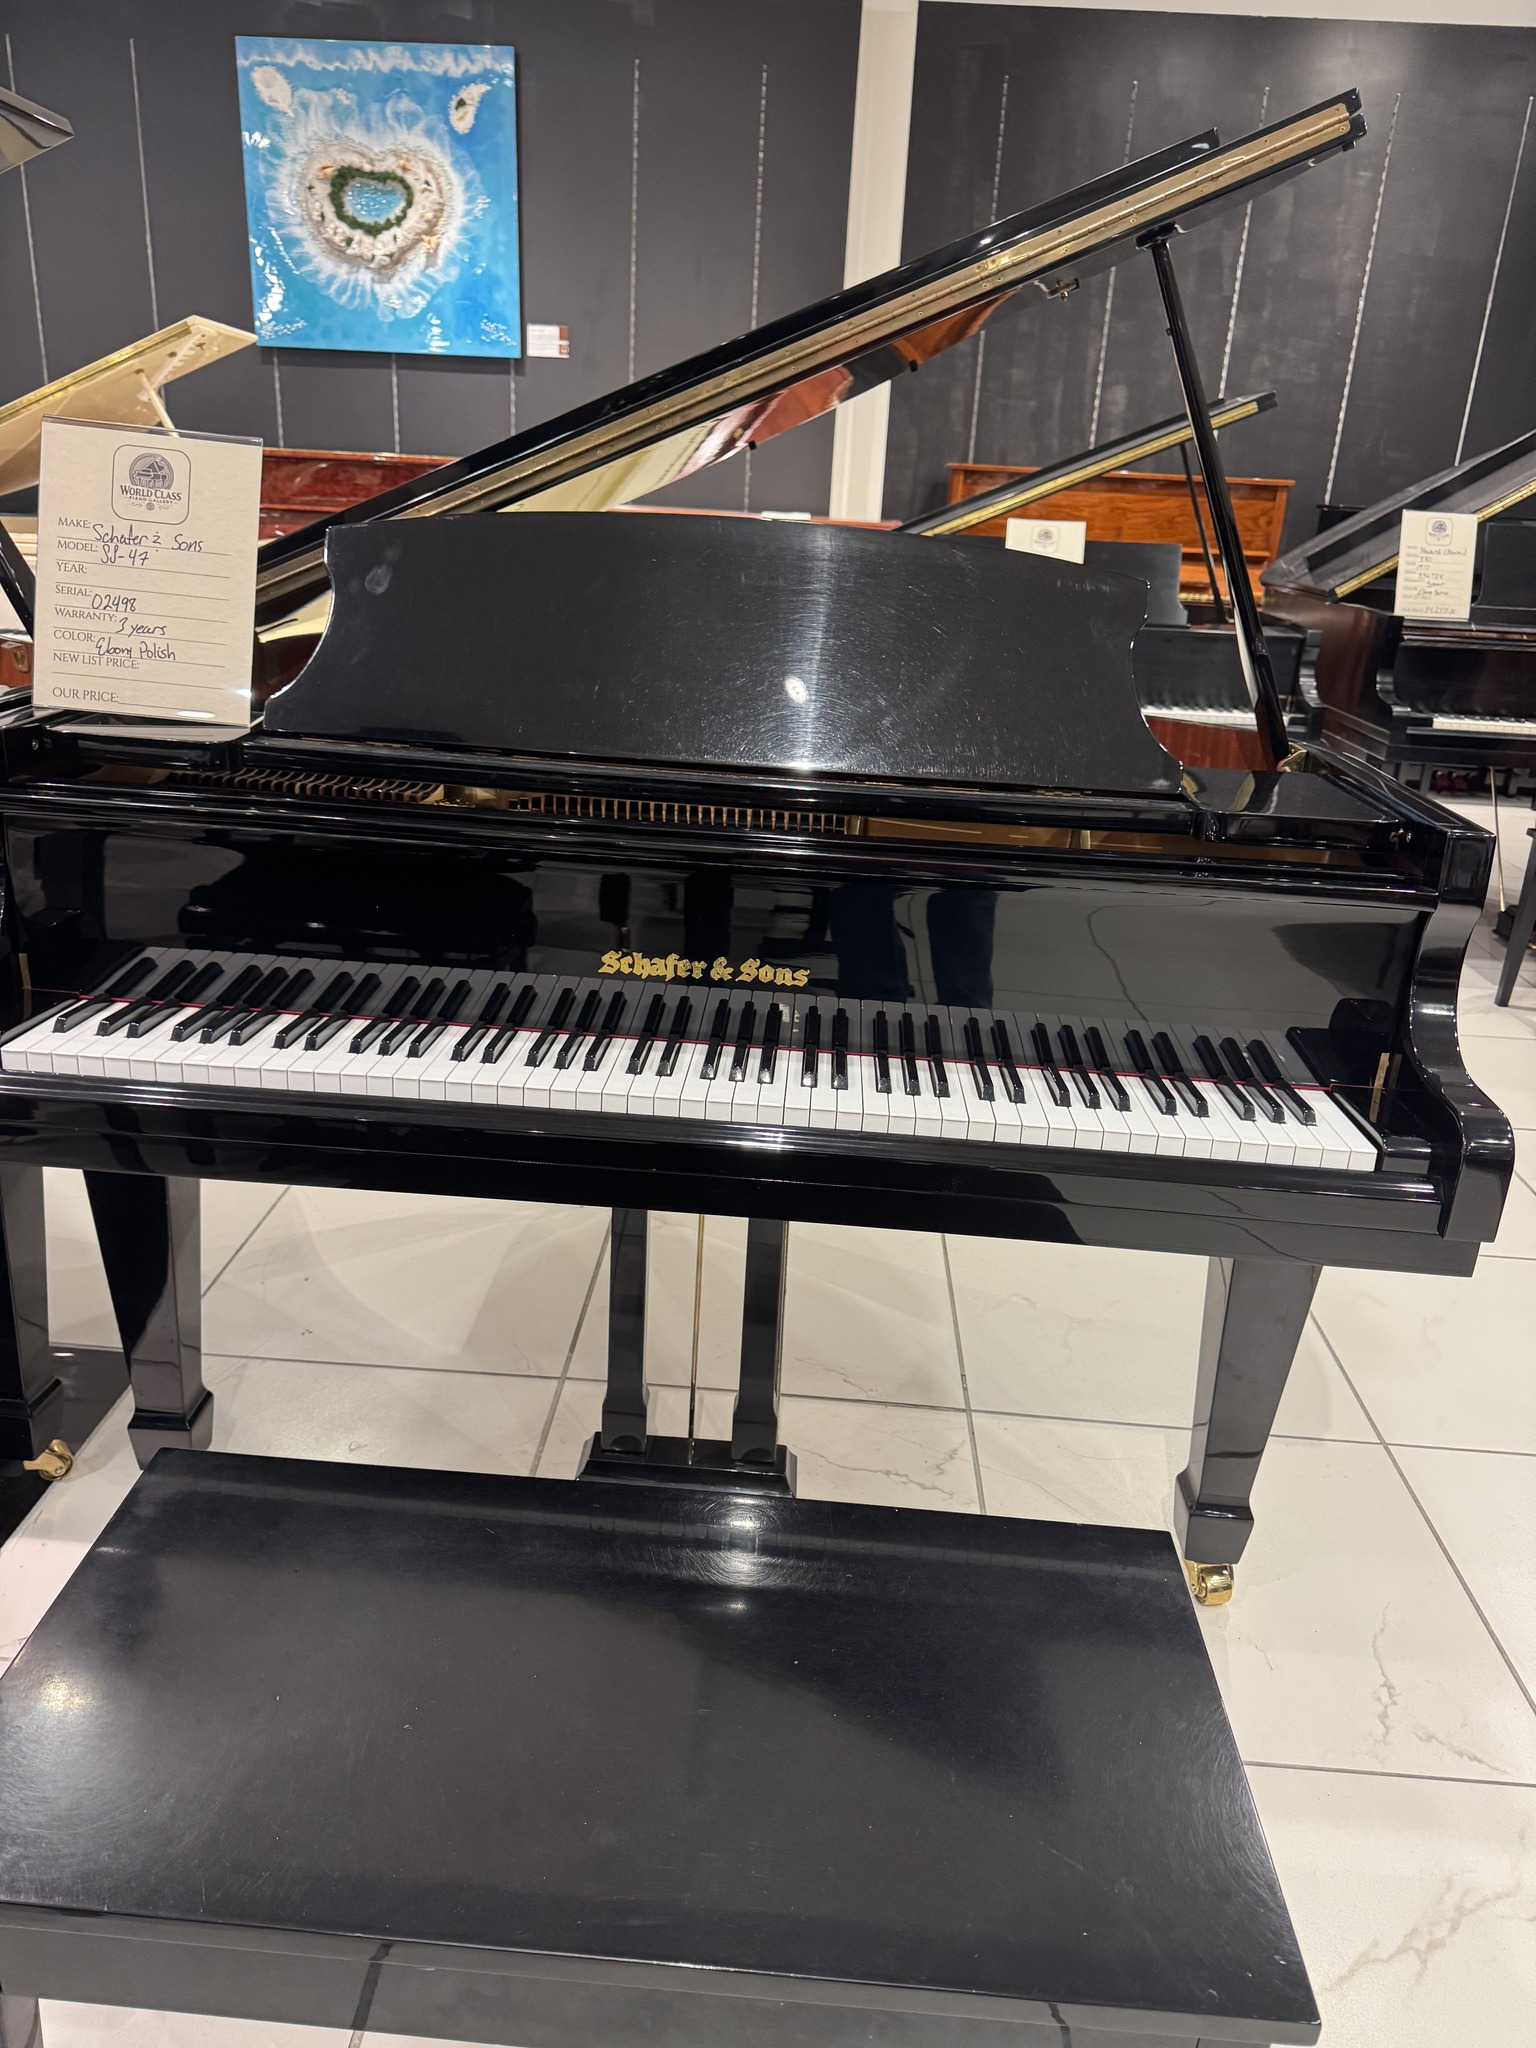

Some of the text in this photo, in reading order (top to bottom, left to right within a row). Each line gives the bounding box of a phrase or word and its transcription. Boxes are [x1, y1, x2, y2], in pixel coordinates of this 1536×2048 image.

[120, 485, 182, 501] WORLD CLASS
[57, 516, 91, 529] MAKE:
[171, 533, 204, 553] Sons
[57, 539, 150, 566] MODEL: SS-47
[56, 561, 88, 574] YEAR:
[55, 584, 137, 613] SERIAL: 02498
[54, 606, 168, 637] WARRANTY: 3 years
[53, 629, 177, 661] COLOR: Ebony Polish
[52, 652, 140, 670] NEW LIST PRICE:
[52, 686, 119, 703] OUR PRICE:
[597, 949, 811, 988] Schafer & Sons
